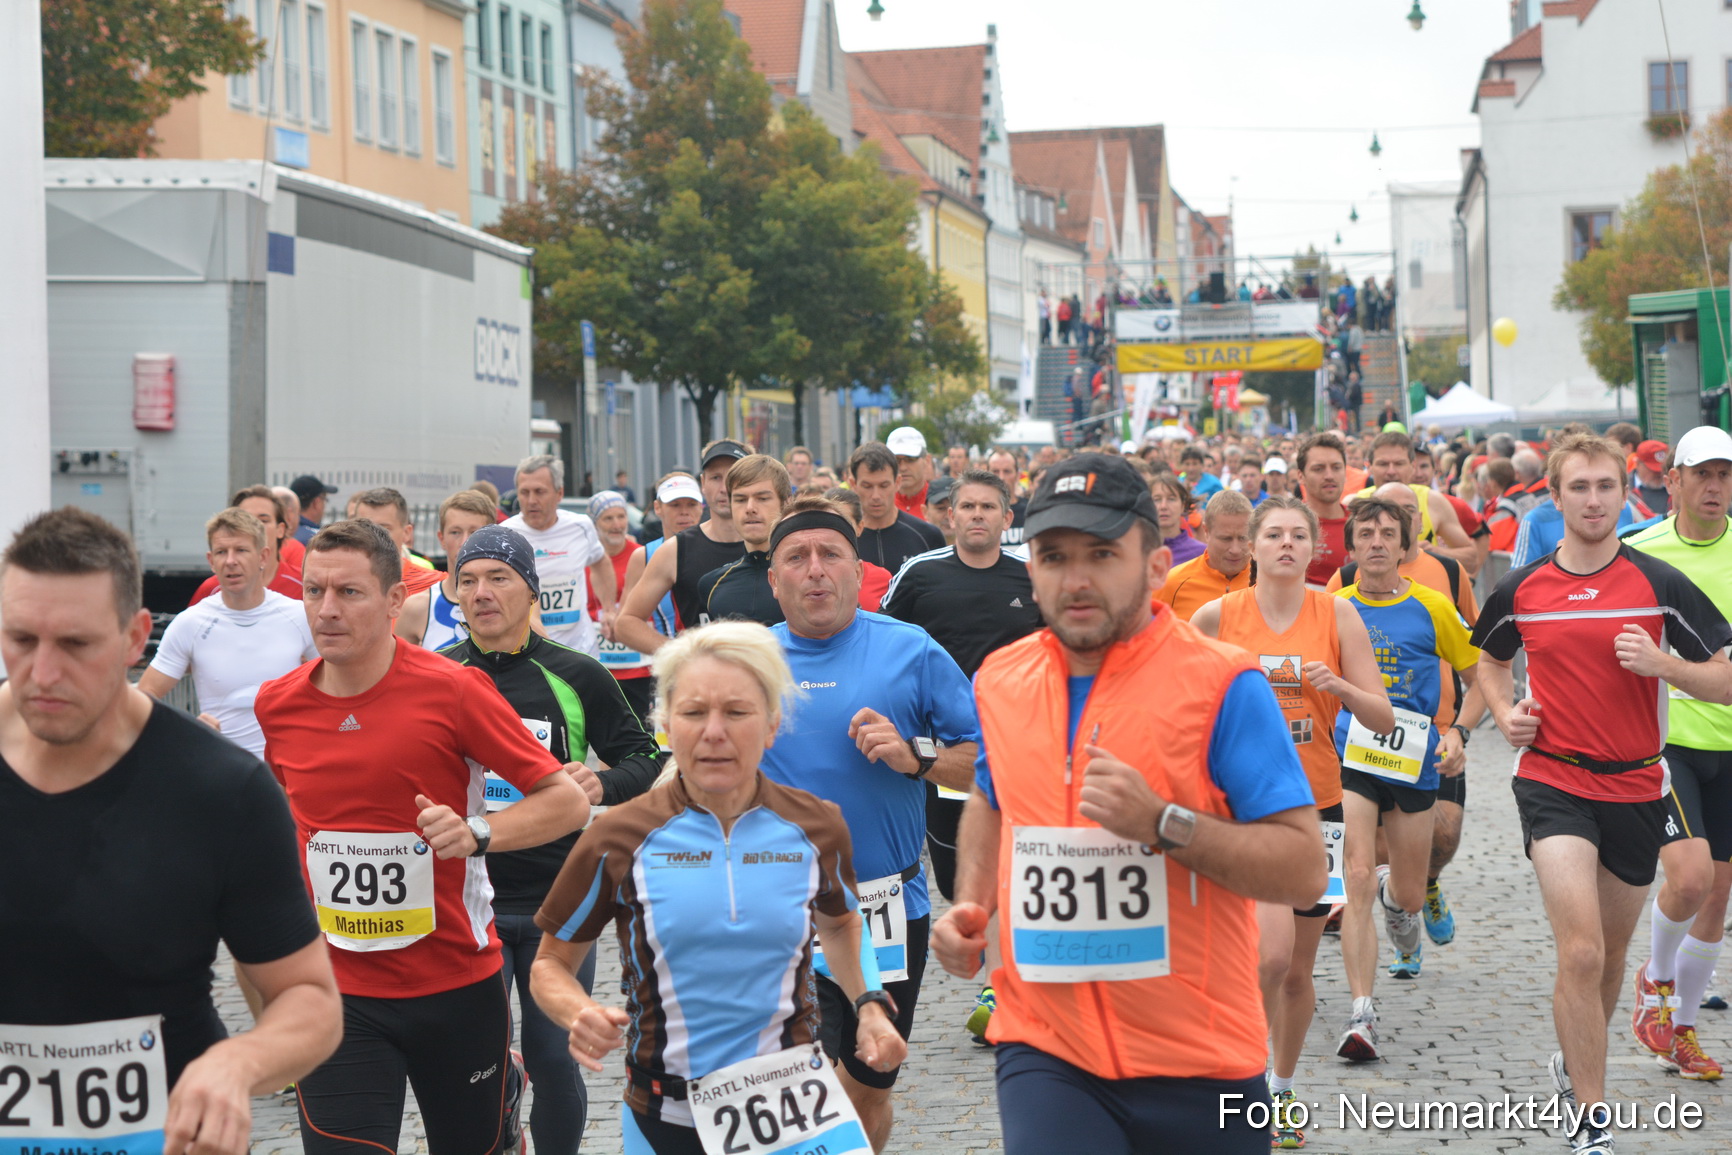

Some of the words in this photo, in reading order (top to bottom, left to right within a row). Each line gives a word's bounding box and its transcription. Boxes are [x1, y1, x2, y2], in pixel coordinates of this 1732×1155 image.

[474, 317, 521, 387] BOCK
[1185, 346, 1254, 366] START
[540, 589, 574, 611] 027
[1567, 593, 1591, 601] JAKO
[1275, 688, 1302, 698] RSCH
[1395, 716, 1417, 727] markt
[1373, 725, 1406, 752] 40
[1364, 752, 1402, 770] Herbert
[487, 786, 511, 799] aus
[308, 841, 344, 855] PARTL
[347, 845, 409, 856] Neumarkt
[774, 852, 803, 863] RACER
[1015, 841, 1053, 856] PARTL
[1057, 843, 1133, 857] Neumarkt
[329, 861, 407, 906] 293
[1023, 865, 1150, 922] 3313
[859, 889, 887, 903] markt
[335, 915, 404, 935] Matthias
[860, 902, 892, 940] 71
[1032, 933, 1131, 965] Stefan
[0, 1041, 39, 1058] RTL
[44, 1038, 133, 1059] Neumarkt
[481, 1063, 497, 1080] asics
[692, 1081, 742, 1106] PARTL
[743, 1060, 806, 1088] Neumarkt
[0, 1061, 149, 1129] 2169
[713, 1078, 841, 1155] 2642
